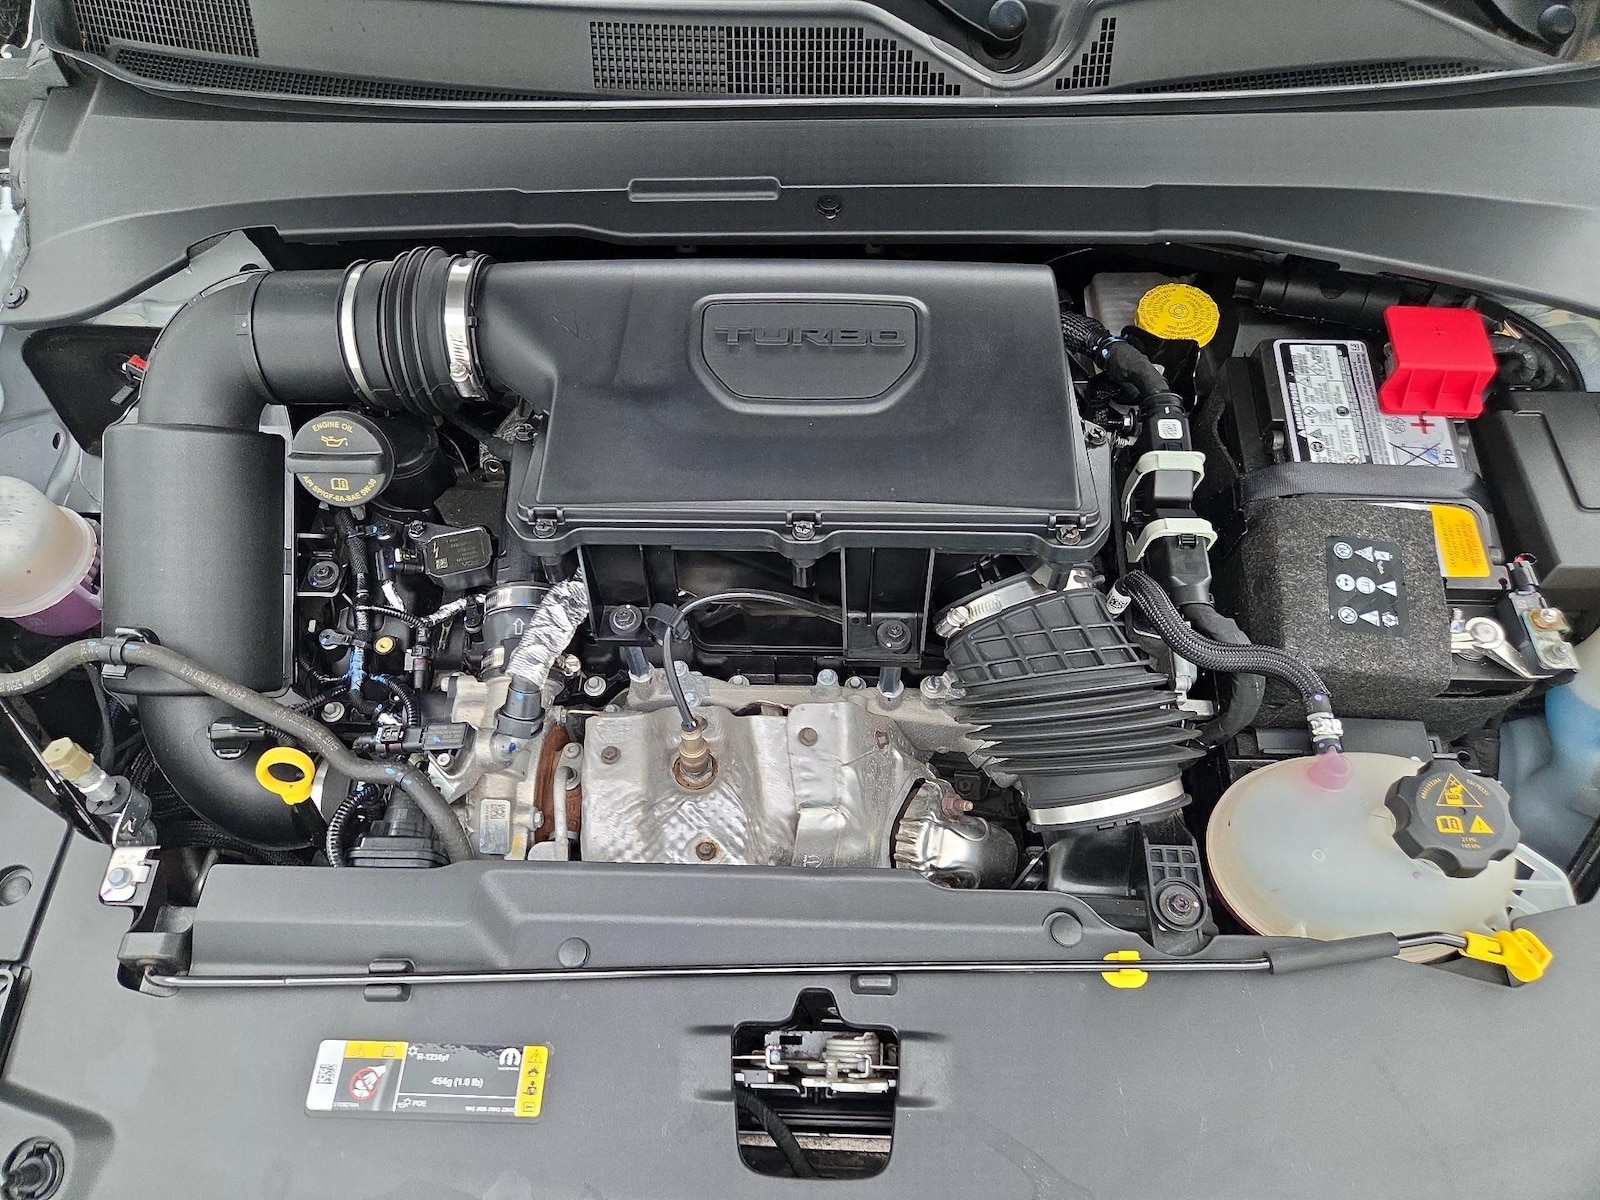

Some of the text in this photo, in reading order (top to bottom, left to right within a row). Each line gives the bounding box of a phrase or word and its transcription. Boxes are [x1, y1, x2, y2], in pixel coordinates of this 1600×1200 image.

[714, 325, 906, 347] TURBO
[311, 421, 354, 434] ENGINE OIL
[1445, 449, 1455, 464] Pb
[302, 475, 313, 488] API
